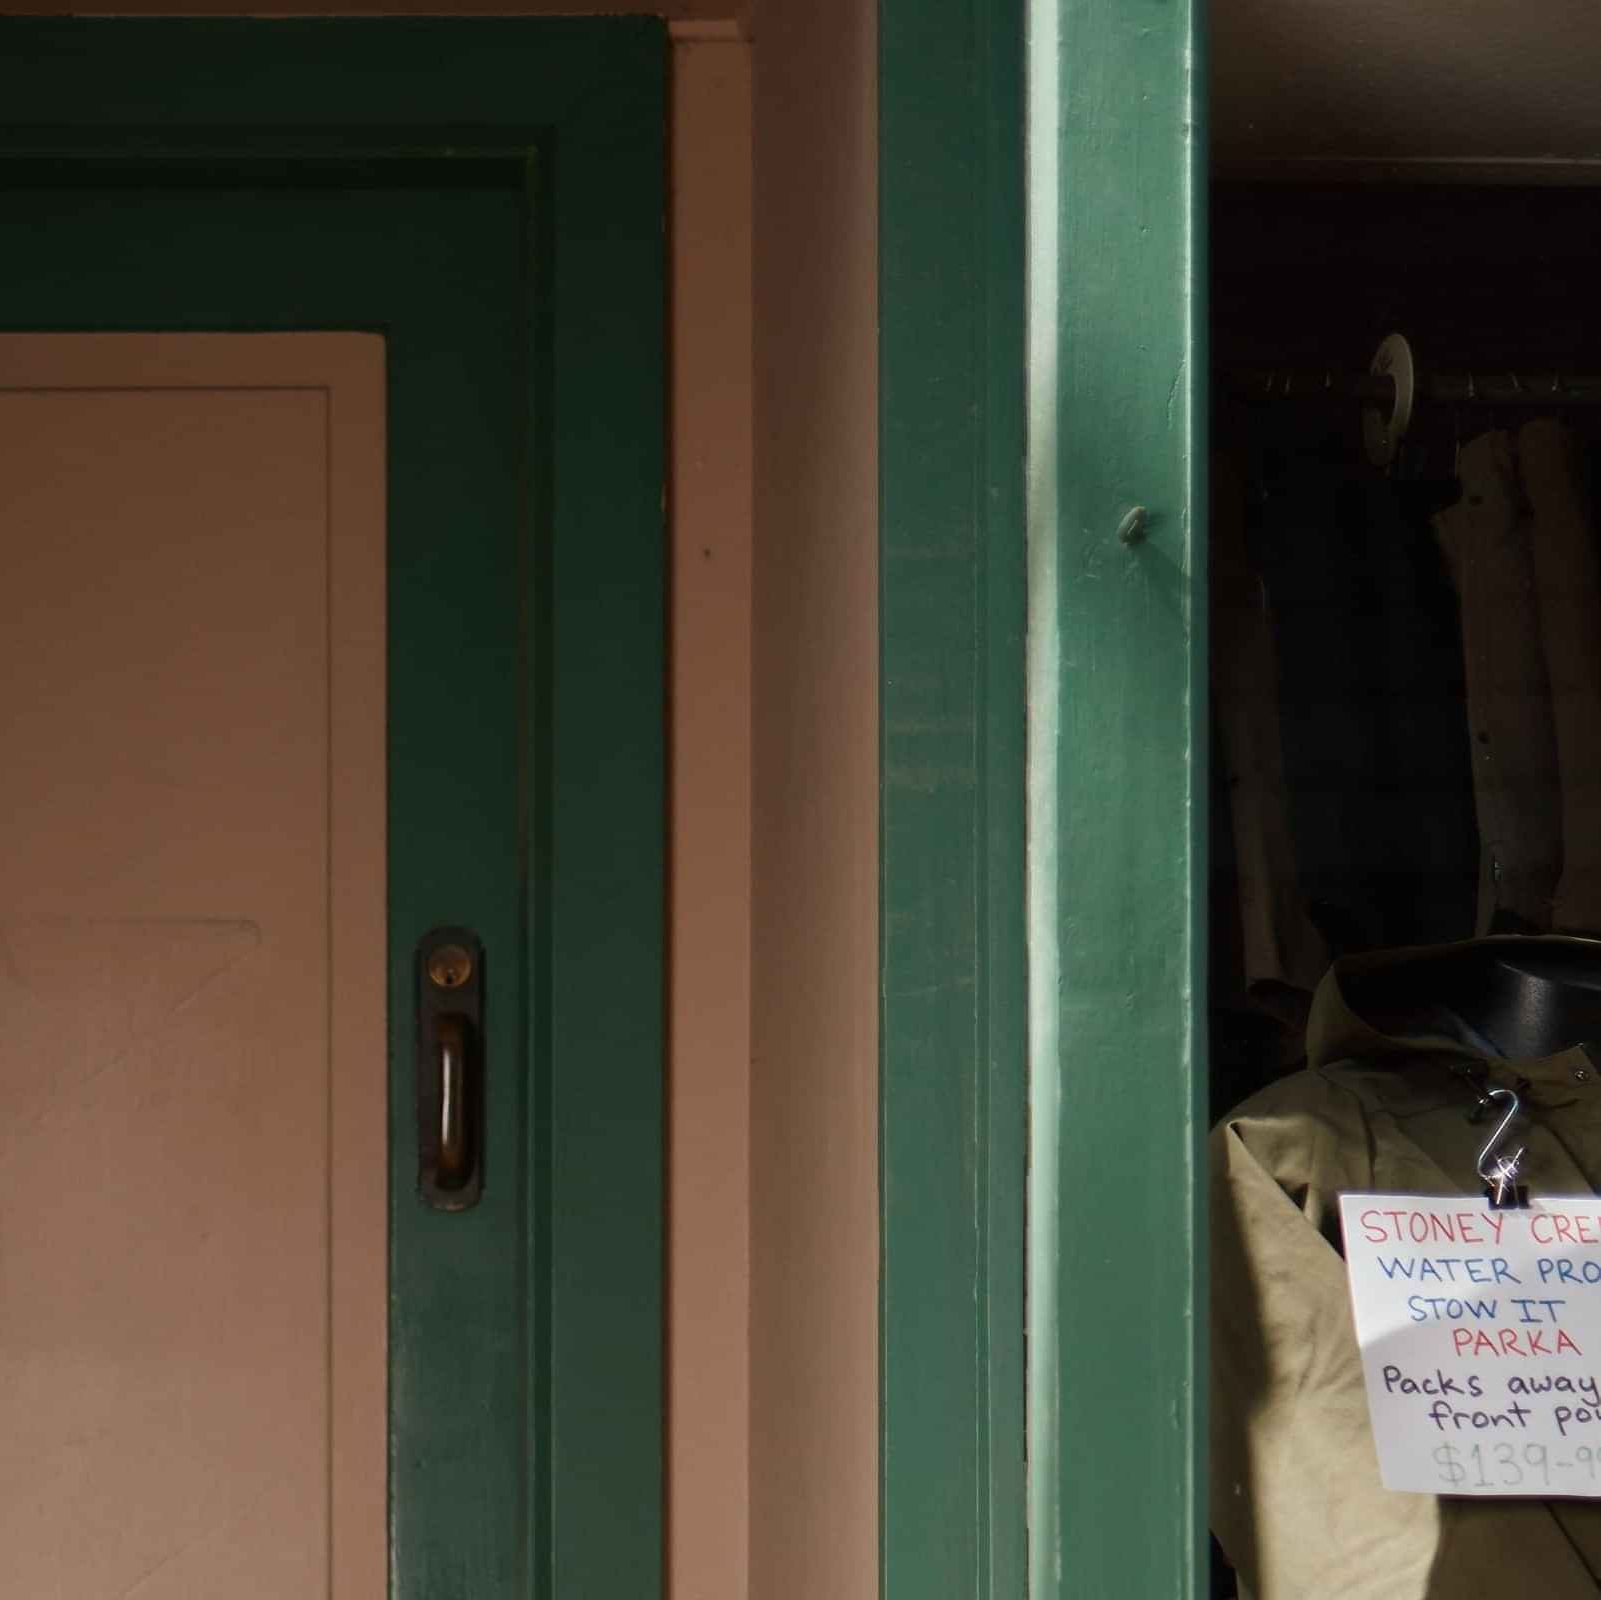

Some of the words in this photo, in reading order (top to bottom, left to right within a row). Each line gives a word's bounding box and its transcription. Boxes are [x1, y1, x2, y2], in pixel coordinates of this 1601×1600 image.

[1360, 1209, 1504, 1245] STONEY
[1530, 1213, 1601, 1245] CRE
[1376, 1255, 1522, 1285] WATER
[1407, 1295, 1498, 1322] STOW
[1510, 1298, 1567, 1324] IT
[1452, 1327, 1583, 1357] PARKA
[1382, 1364, 1484, 1398] Packs
[1506, 1374, 1601, 1408] away
[1428, 1399, 1532, 1431] front
